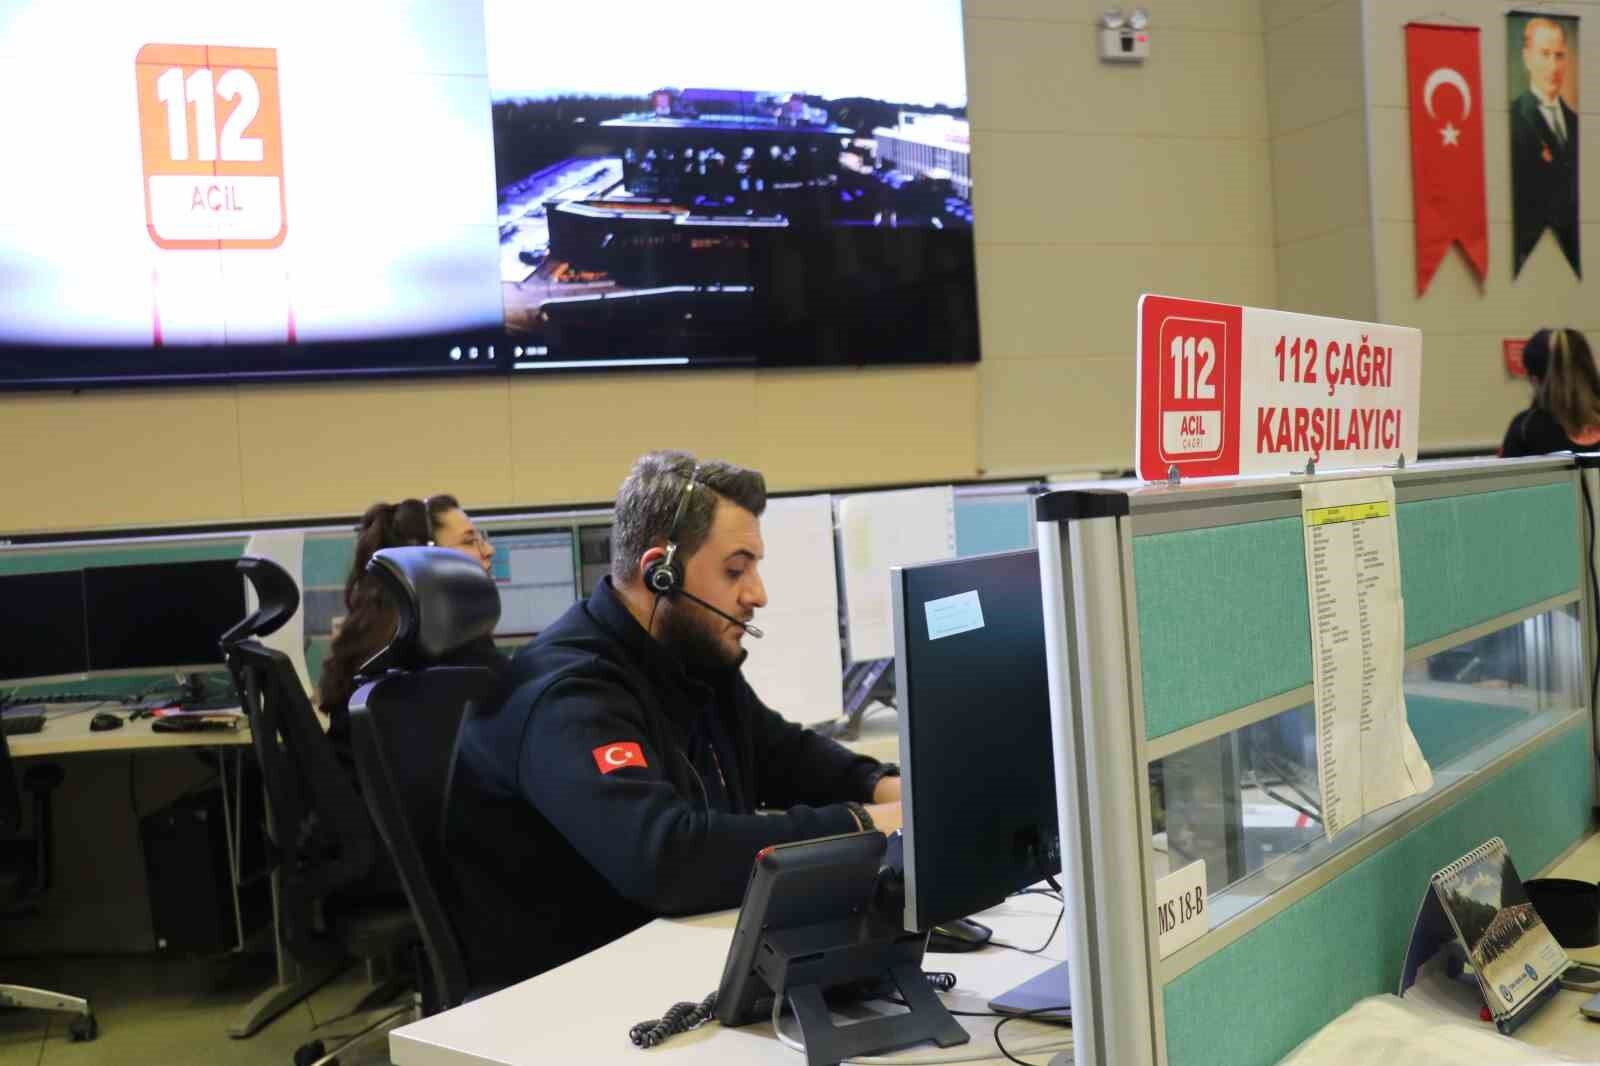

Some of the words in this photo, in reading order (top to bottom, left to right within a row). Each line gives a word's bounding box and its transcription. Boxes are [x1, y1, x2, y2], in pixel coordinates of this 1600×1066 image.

[157, 66, 264, 162] 112
[1170, 335, 1216, 400] 112
[1274, 336, 1318, 384] 112
[1325, 334, 1393, 397] ÇAĞRI
[1256, 406, 1402, 464] KARŞILAYICI
[1157, 899, 1176, 935] MS
[1179, 885, 1203, 924] 18-B
